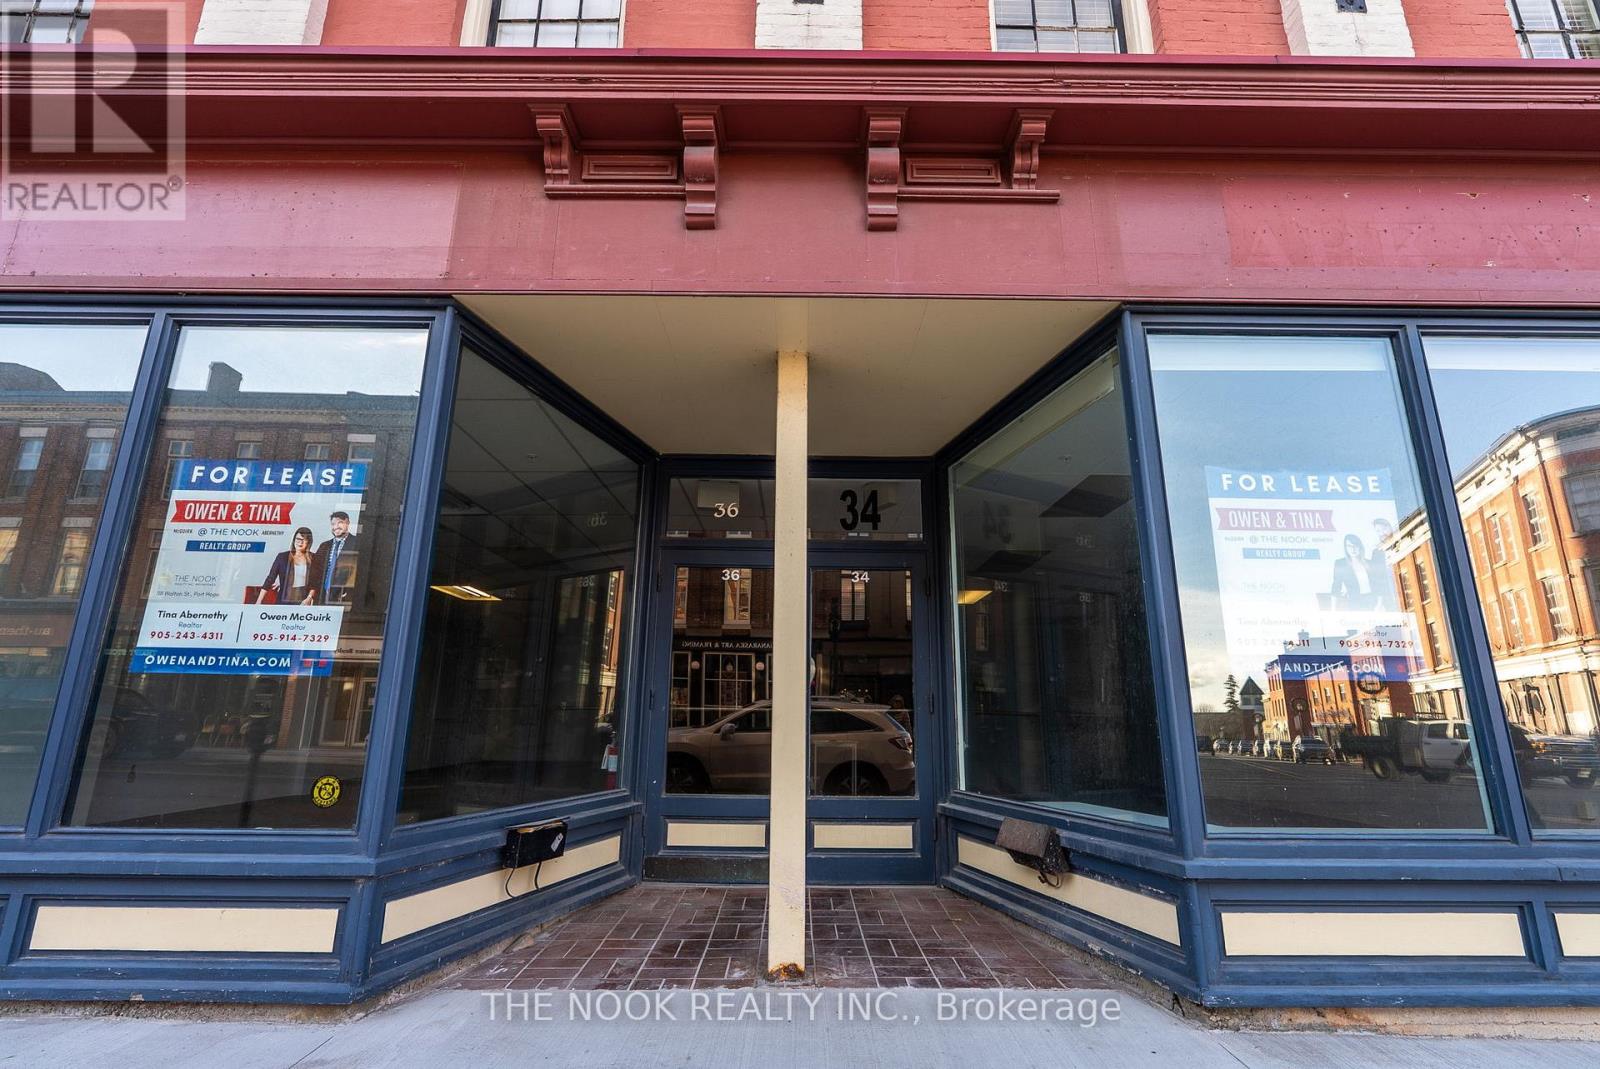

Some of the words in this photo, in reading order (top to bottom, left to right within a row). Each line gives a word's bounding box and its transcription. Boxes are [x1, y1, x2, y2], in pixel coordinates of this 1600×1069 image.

[190, 465, 249, 484] FOR
[263, 467, 354, 486] LEASE
[1221, 473, 1276, 492] FOR
[1290, 475, 1381, 493] LEASE
[184, 502, 228, 521] OWEN
[232, 504, 244, 521] &
[249, 504, 281, 522] TINA
[713, 502, 739, 518] 36
[839, 489, 881, 531] 34
[1228, 511, 1271, 528] OWEN
[1275, 512, 1287, 529] &
[1290, 512, 1325, 529] TINA
[197, 528, 208, 537] @
[210, 528, 228, 536] THE
[230, 528, 260, 537] NOOK
[199, 542, 226, 550] REALTY
[227, 543, 252, 551] GROUP
[721, 569, 740, 581] 36
[851, 571, 870, 582] 34
[157, 610, 177, 619] Tina
[179, 611, 228, 622] Abernethy
[259, 613, 288, 621] Owen
[289, 613, 332, 622] McGuirk
[178, 621, 203, 629] Realtor
[281, 623, 306, 631] Realtor
[150, 631, 224, 640] 905-243-4311
[252, 633, 330, 643] 905-914-7329
[1339, 639, 1414, 649] 905-914-7329
[144, 655, 291, 668] OWENANDTINA.COM
